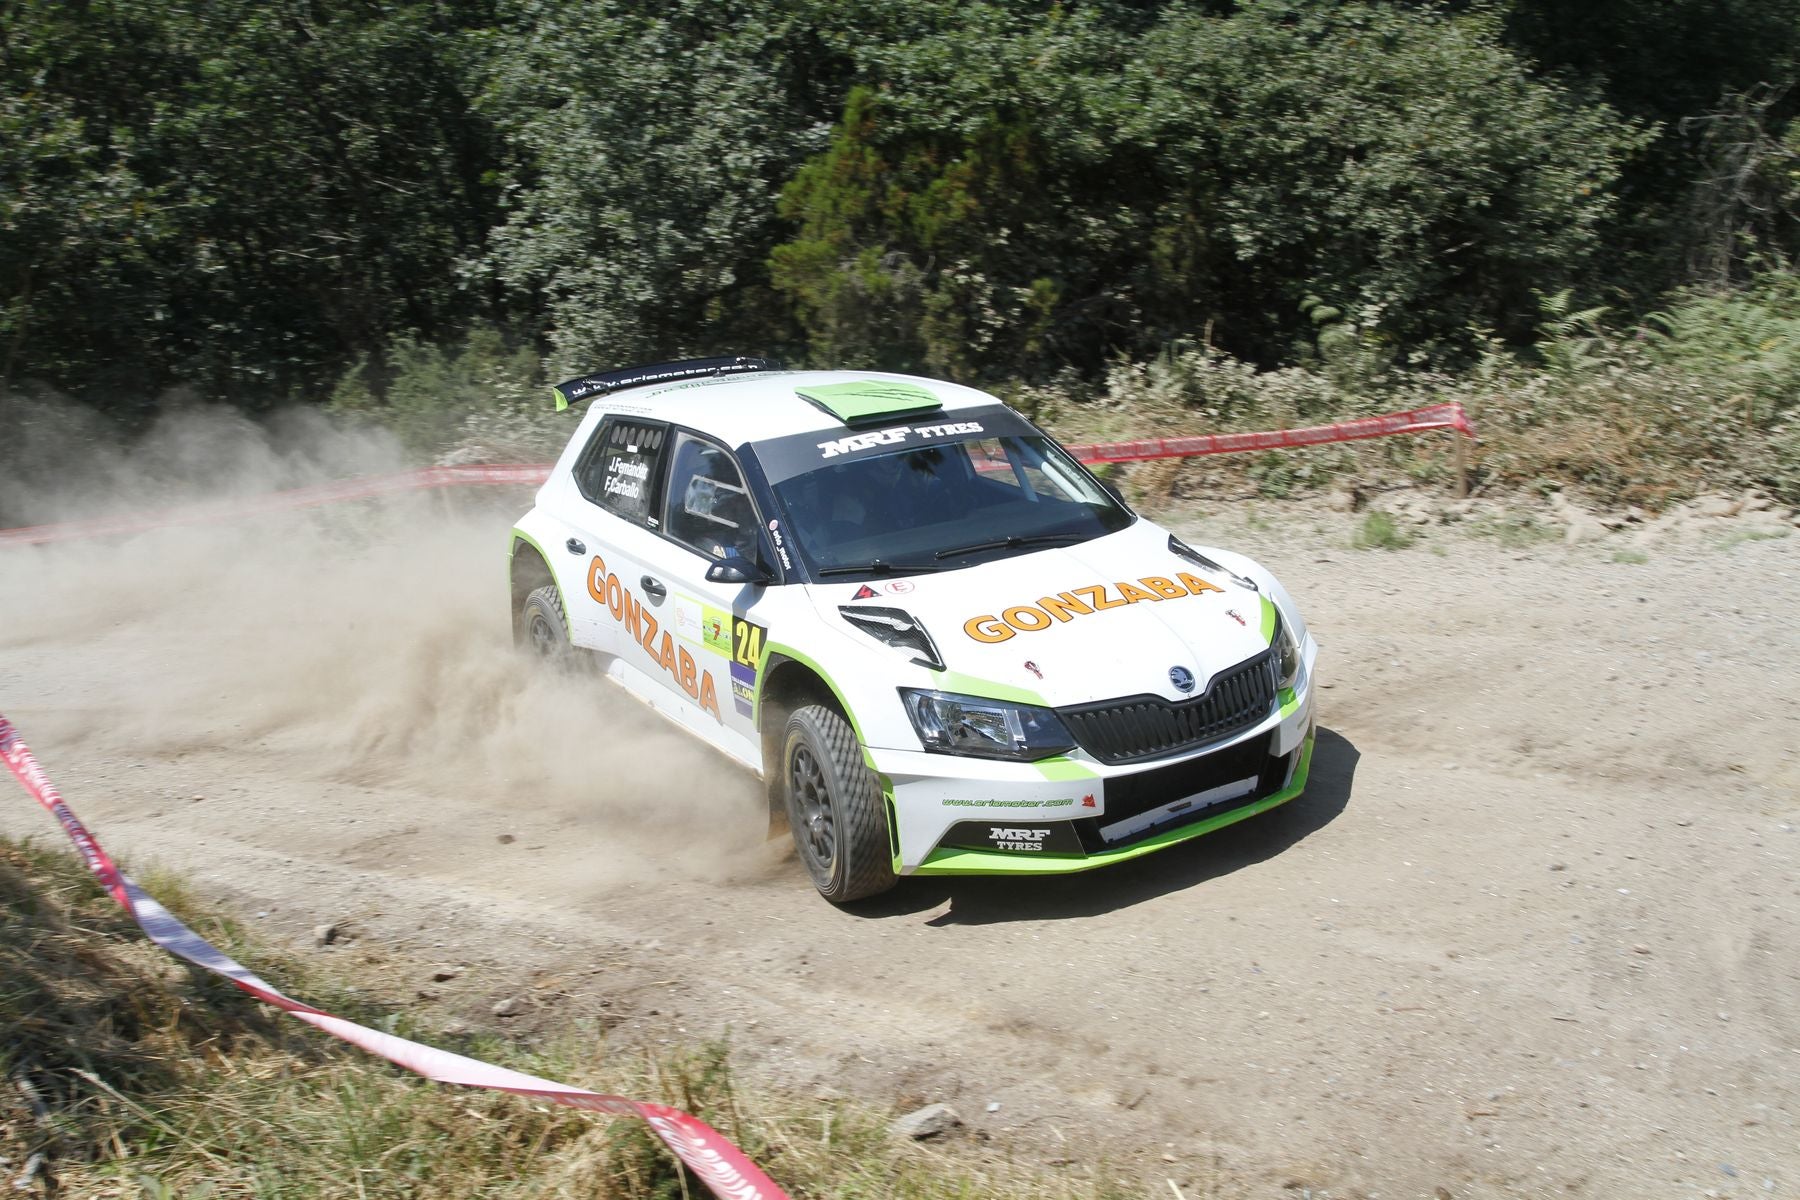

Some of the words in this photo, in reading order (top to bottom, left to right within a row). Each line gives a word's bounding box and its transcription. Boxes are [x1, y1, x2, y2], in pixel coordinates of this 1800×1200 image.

[818, 427, 911, 459] MRF
[914, 422, 984, 438] TYRES
[963, 572, 1226, 644] GONZABA
[586, 554, 724, 727] GONZABA
[712, 623, 721, 641] 7
[736, 621, 761, 672] 24
[989, 827, 1050, 841] MRF
[997, 841, 1043, 851] TYRES
